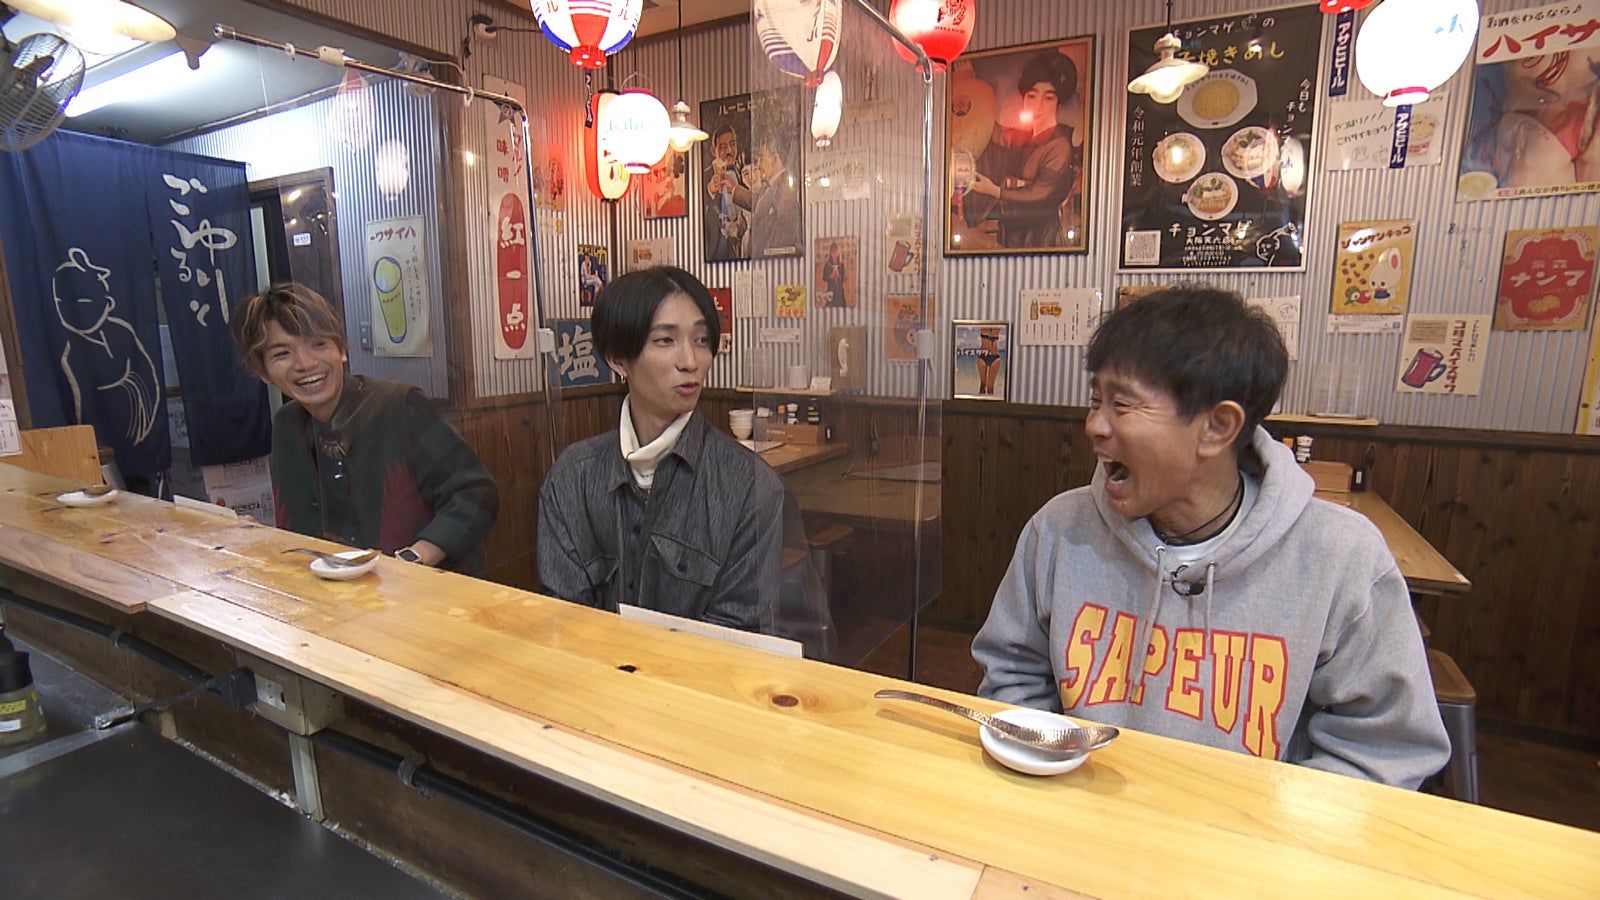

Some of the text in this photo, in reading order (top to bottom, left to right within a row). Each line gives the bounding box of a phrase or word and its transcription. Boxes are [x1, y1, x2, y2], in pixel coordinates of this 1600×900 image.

[499, 216, 526, 333] 紅一点
[557, 324, 601, 382] 塩
[1059, 601, 1289, 761] SAPEUR
